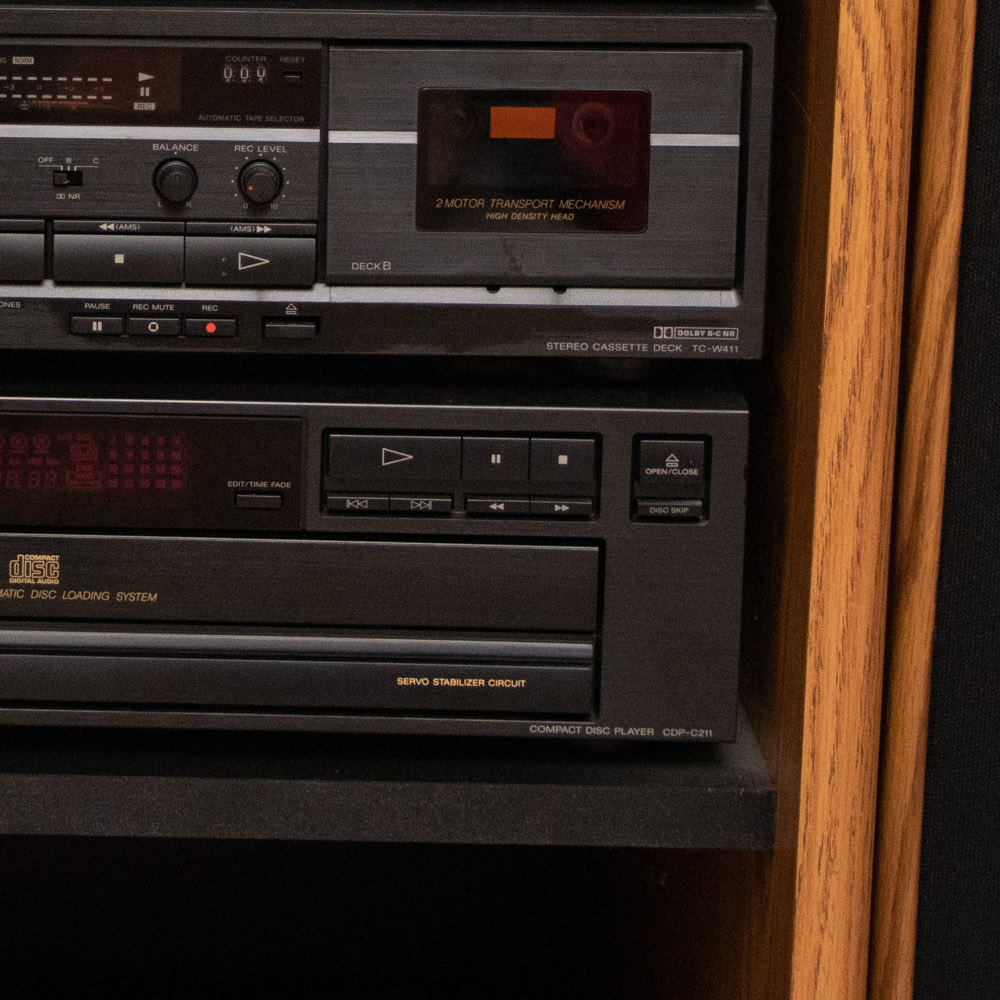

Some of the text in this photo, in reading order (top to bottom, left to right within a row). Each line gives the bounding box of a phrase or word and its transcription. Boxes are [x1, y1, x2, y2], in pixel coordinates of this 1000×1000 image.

[235, 145, 254, 153] REC
[445, 199, 485, 208] MOTOR
[490, 199, 555, 209] TRANSPORT
[559, 200, 625, 210] MECHANISM
[511, 213, 547, 221] DENSITY
[352, 261, 391, 271] DECK B
[546, 342, 738, 353] STEREO CASSETTE DECK TC-W411
[645, 468, 698, 476] OPEN/CLOSE
[31, 589, 56, 599] DISC
[62, 590, 110, 600] LOADING
[116, 591, 157, 601] SYSTEM
[397, 677, 525, 687] SERVO STABILIZER CIRCUIT
[529, 725, 712, 737] COMPACT DISC PLAYER CDP-C211
